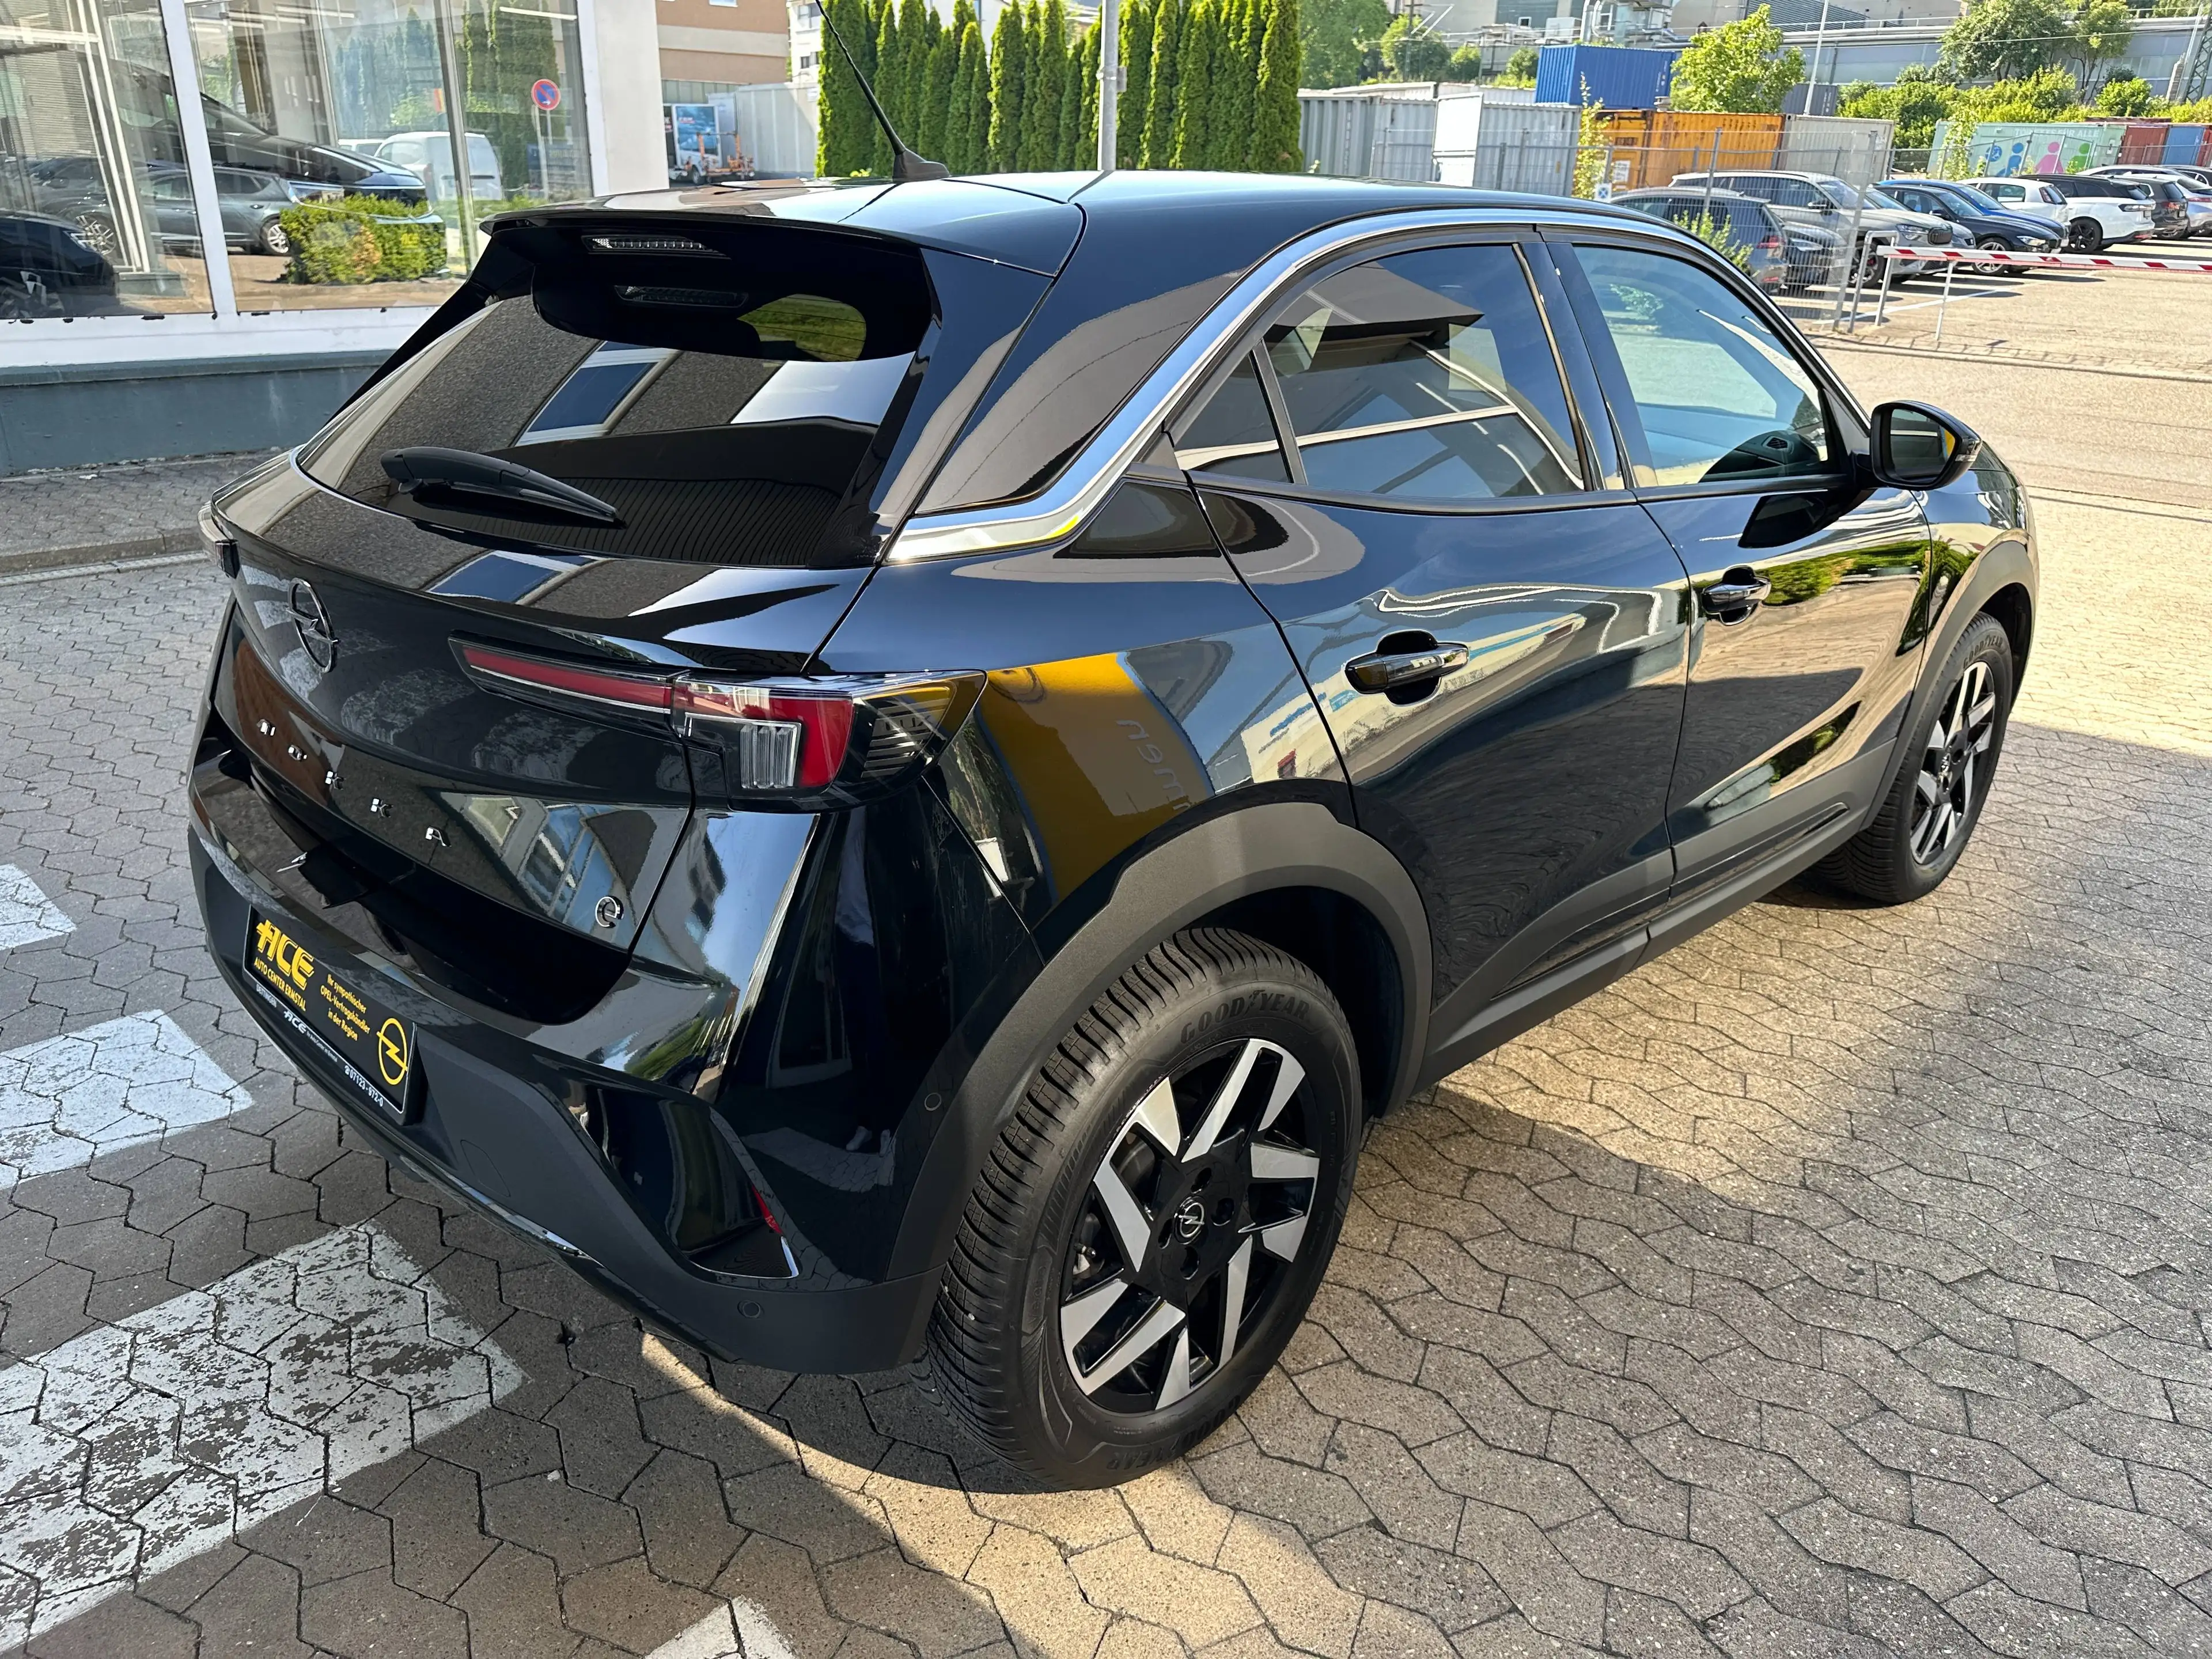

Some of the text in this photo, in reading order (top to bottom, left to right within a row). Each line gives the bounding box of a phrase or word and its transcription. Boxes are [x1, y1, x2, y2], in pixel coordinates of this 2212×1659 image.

[256, 919, 315, 990] ACE
[254, 957, 306, 1012] AUTO CENTER ERMSTAL
[334, 982, 366, 1013] sympathischer
[283, 1010, 306, 1033] ACE
[328, 1007, 358, 1041] in der Region
[1181, 989, 1310, 1044] GOODYEAR
